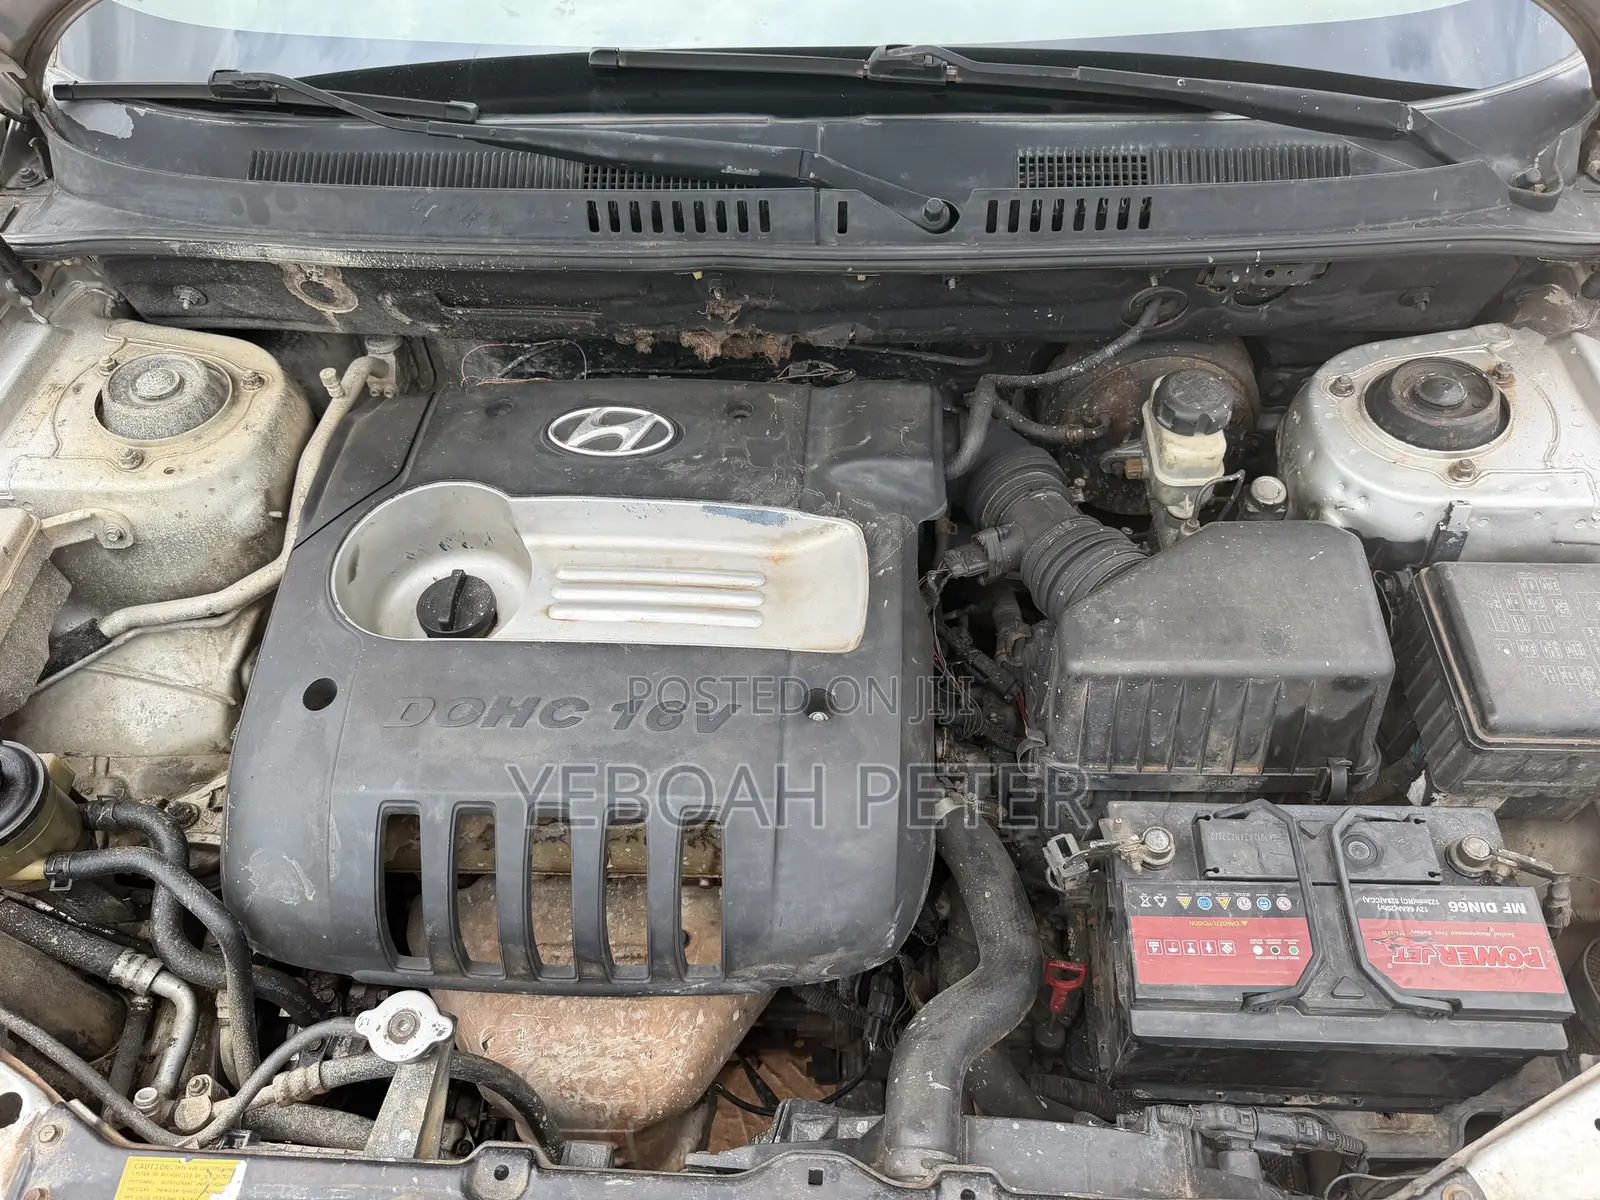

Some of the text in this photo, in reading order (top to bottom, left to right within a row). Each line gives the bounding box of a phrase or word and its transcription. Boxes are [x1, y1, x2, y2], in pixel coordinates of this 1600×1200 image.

[382, 696, 589, 729] DOHC
[1416, 905, 1429, 913] 12V
[1447, 901, 1527, 914] MF DIN66
[1392, 945, 1546, 969] POWER JET
